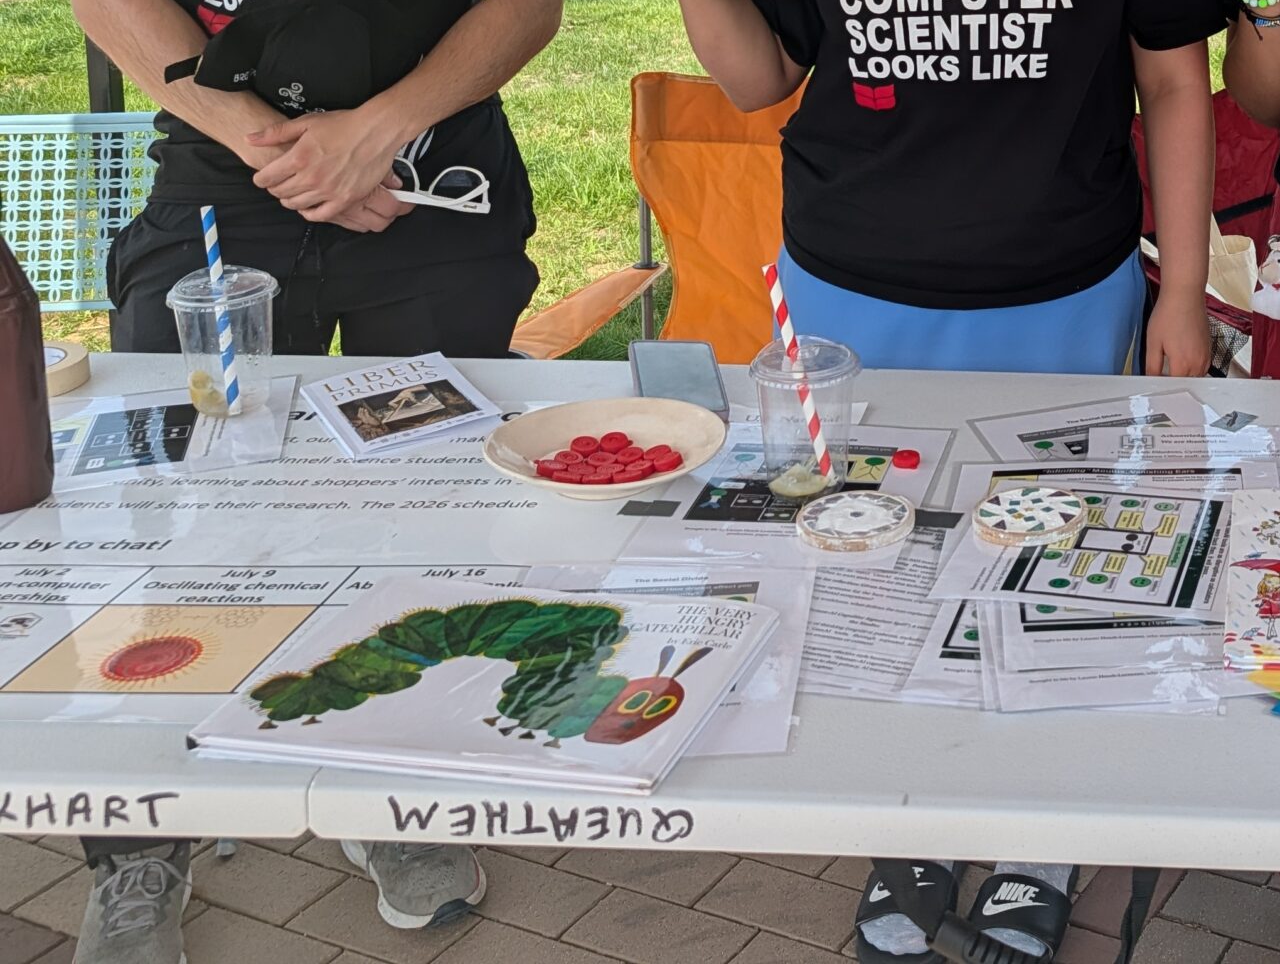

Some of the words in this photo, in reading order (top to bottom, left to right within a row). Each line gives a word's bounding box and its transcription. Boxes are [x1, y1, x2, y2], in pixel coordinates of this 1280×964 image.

[846, 12, 1053, 55] SCIENTIST
[849, 54, 960, 82] LOOKS
[972, 53, 1048, 81] LIKE
[324, 360, 437, 393] LIBER
[331, 370, 439, 402] PRIMUS
[406, 456, 484, 465] students
[171, 477, 248, 487] learning
[251, 477, 311, 486] about
[408, 477, 490, 486] interests
[495, 477, 513, 486] in
[117, 500, 155, 509] will
[156, 500, 209, 509] share
[213, 500, 262, 509] their
[264, 500, 351, 509] research.
[360, 500, 397, 509] The
[399, 500, 450, 509] 2026
[451, 499, 538, 508] schedule
[23, 539, 61, 553] by
[64, 539, 92, 550] to
[98, 539, 173, 551] chat!
[16, 568, 48, 577] July
[56, 568, 72, 576] 2
[221, 569, 259, 578] July
[262, 569, 277, 577] 9
[421, 568, 459, 578] July
[462, 568, 488, 577] 16
[0, 581, 113, 591] n-computer
[143, 581, 241, 592] Oscillating
[245, 580, 329, 590] chemical
[346, 581, 375, 590] Ab
[0, 593, 71, 603] erships
[176, 594, 266, 604] reactions
[677, 605, 712, 615] THE
[714, 606, 757, 620] VERY
[678, 615, 751, 630] HUNGRY
[629, 623, 743, 640] CATERPILLAR
[704, 640, 733, 650] Carle
[995, 881, 1040, 904] NIKE
